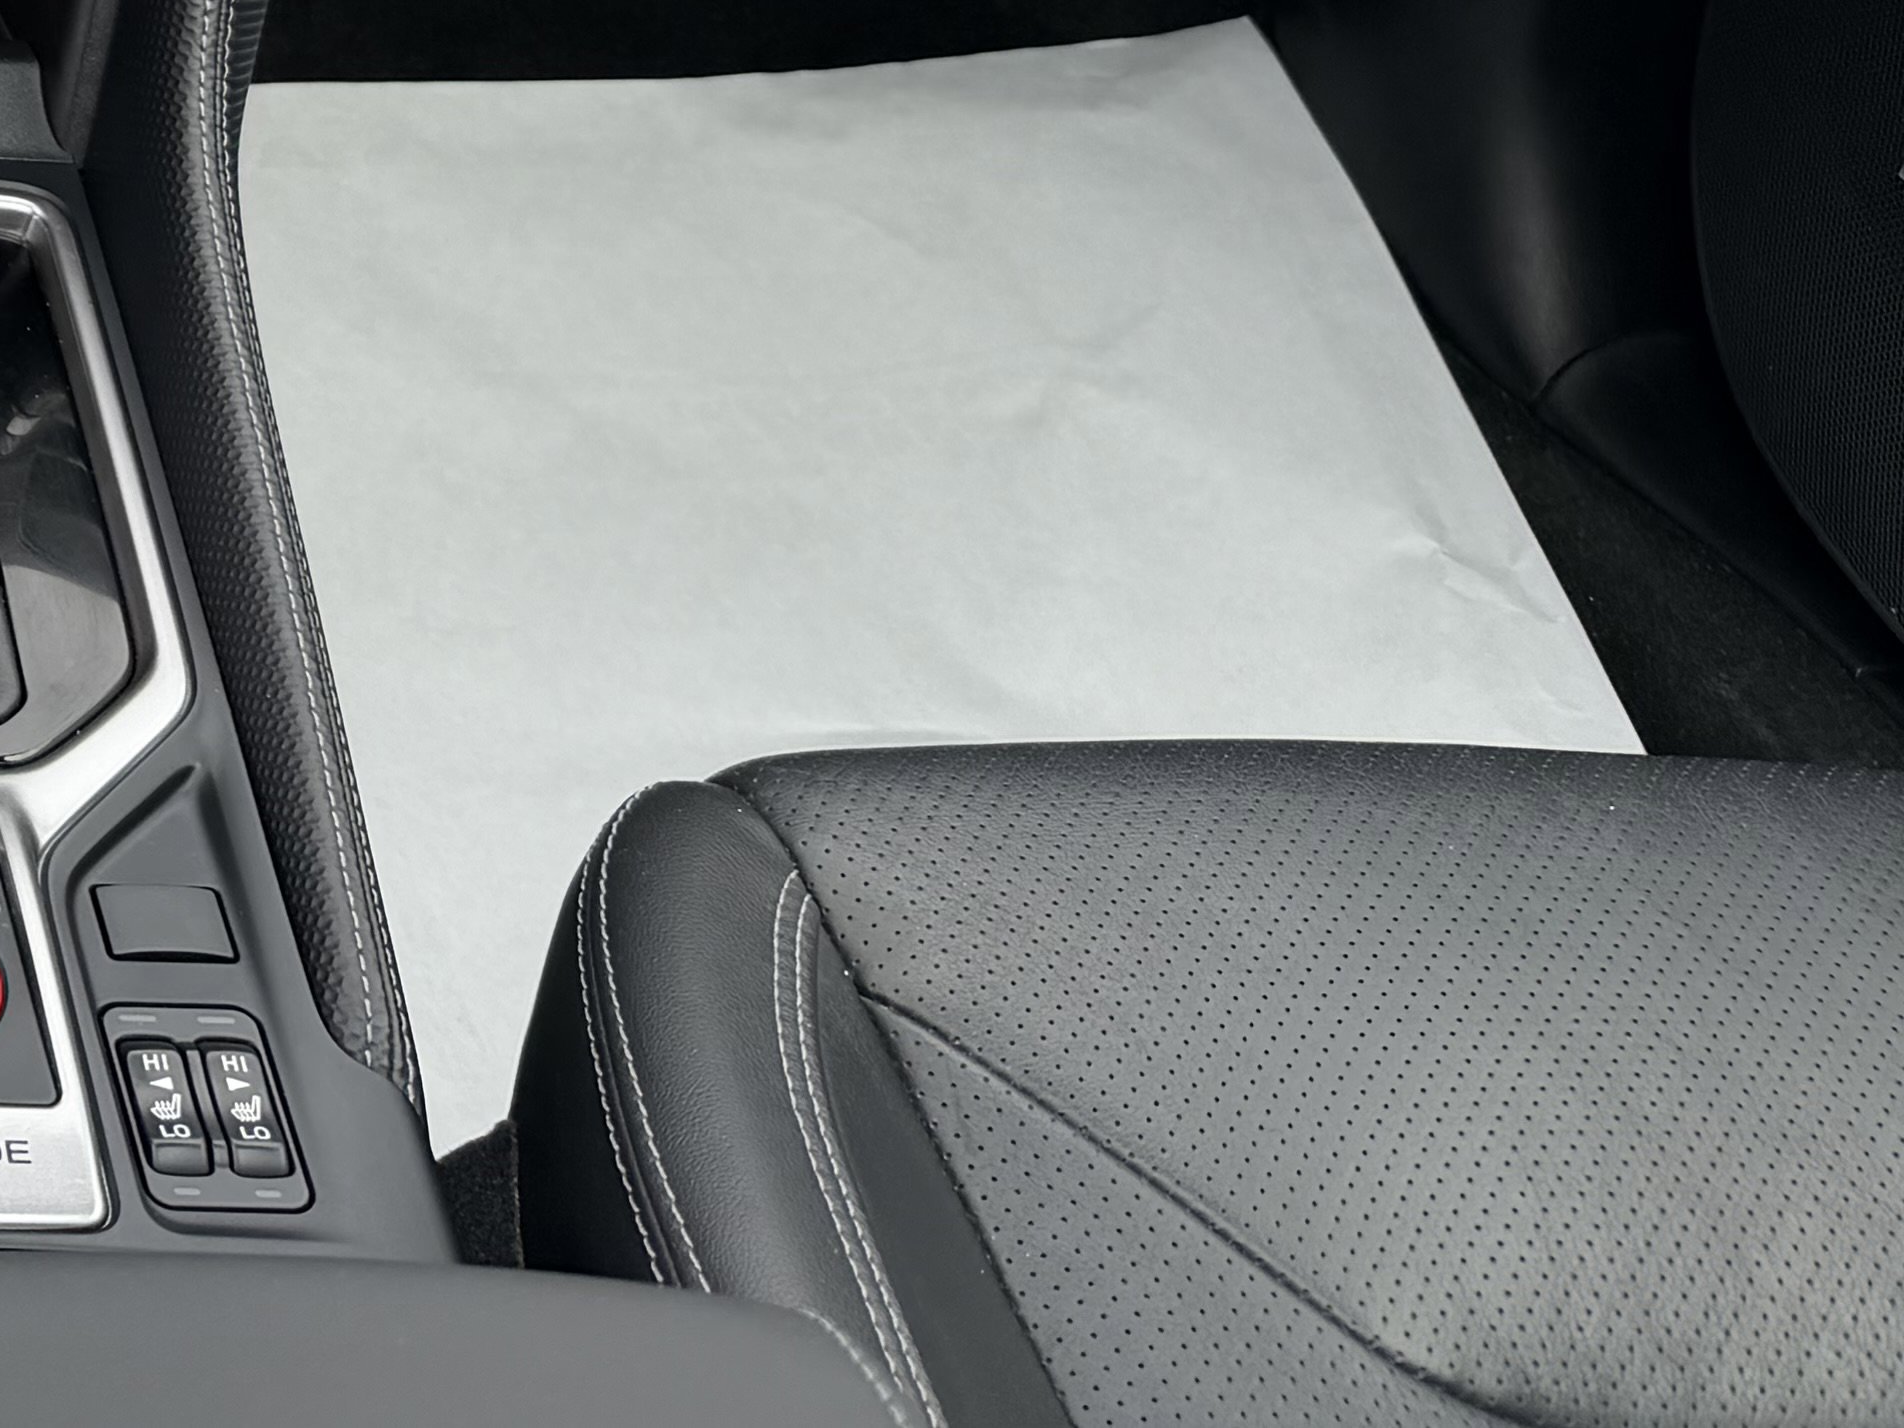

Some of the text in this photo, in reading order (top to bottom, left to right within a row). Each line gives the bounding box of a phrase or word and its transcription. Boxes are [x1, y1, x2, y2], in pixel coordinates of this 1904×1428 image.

[142, 1053, 169, 1071] HI
[221, 1055, 248, 1073] HI
[159, 1124, 191, 1138] LO
[239, 1126, 271, 1140] LO
